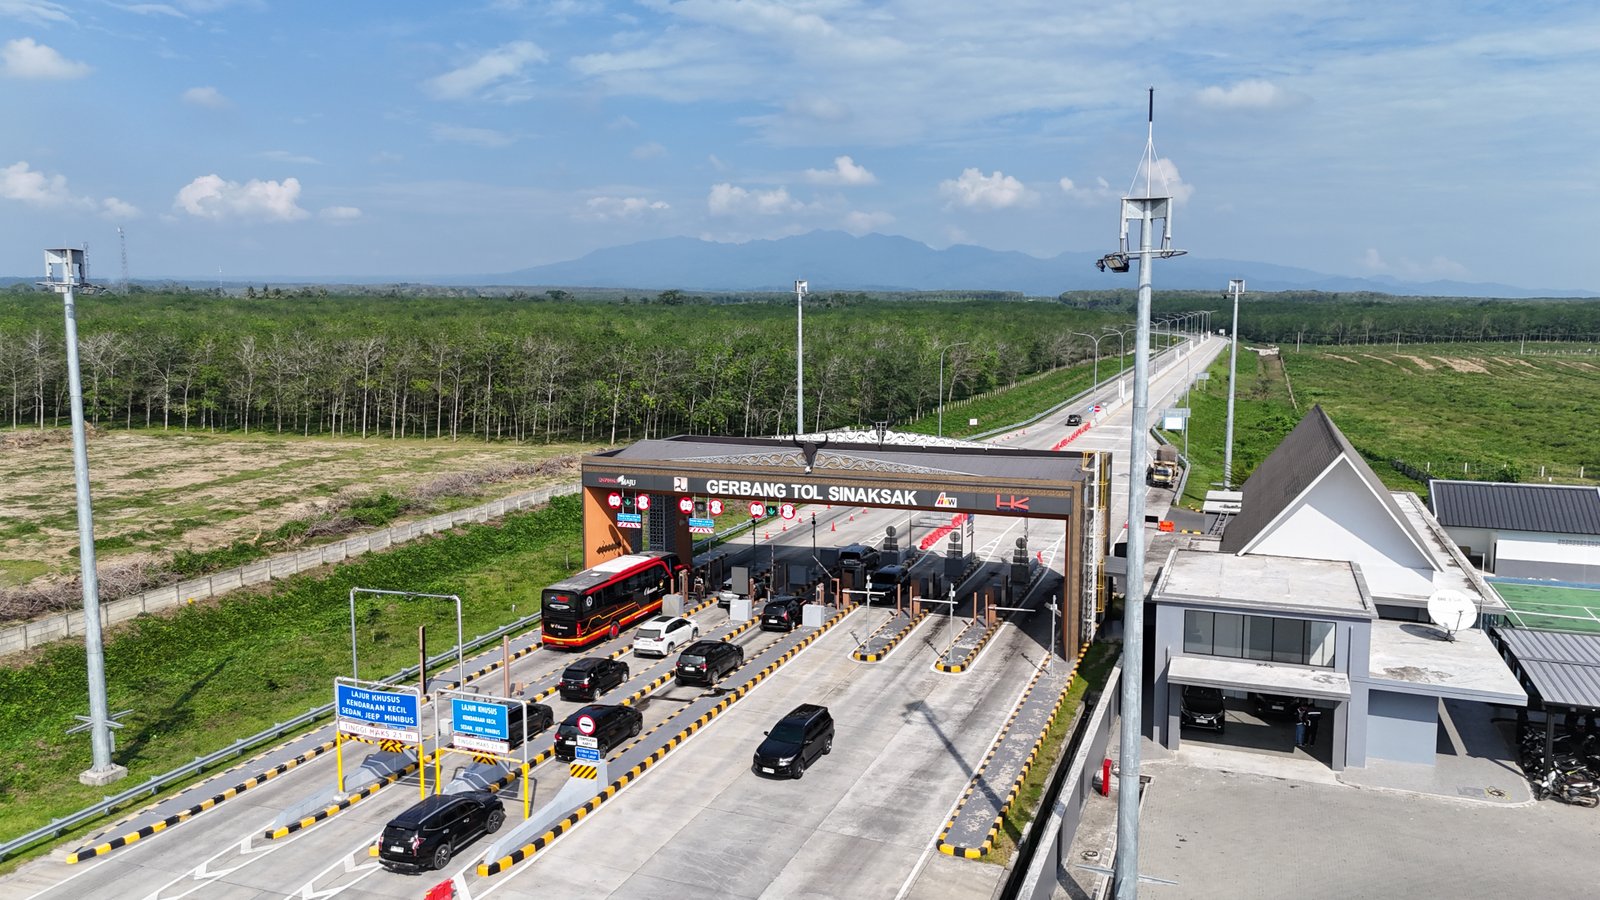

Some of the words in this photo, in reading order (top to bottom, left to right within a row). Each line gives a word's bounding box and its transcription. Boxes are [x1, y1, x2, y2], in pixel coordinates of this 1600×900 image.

[706, 479, 786, 498] GERBANG
[791, 483, 823, 500] TOL
[828, 486, 918, 506] SINAKSAK
[996, 494, 1030, 510] HK
[351, 690, 370, 701] LAJUR
[371, 695, 401, 704] KHUSUS
[346, 698, 385, 711] KENDARAAN
[387, 705, 407, 714] KECIL
[461, 703, 477, 712] LAJUR
[478, 705, 497, 716] KHUSUS
[364, 711, 380, 720] JEEP
[384, 714, 415, 724] MINIBUS
[345, 723, 367, 733] TINGGI
[369, 728, 390, 737] MAKS
